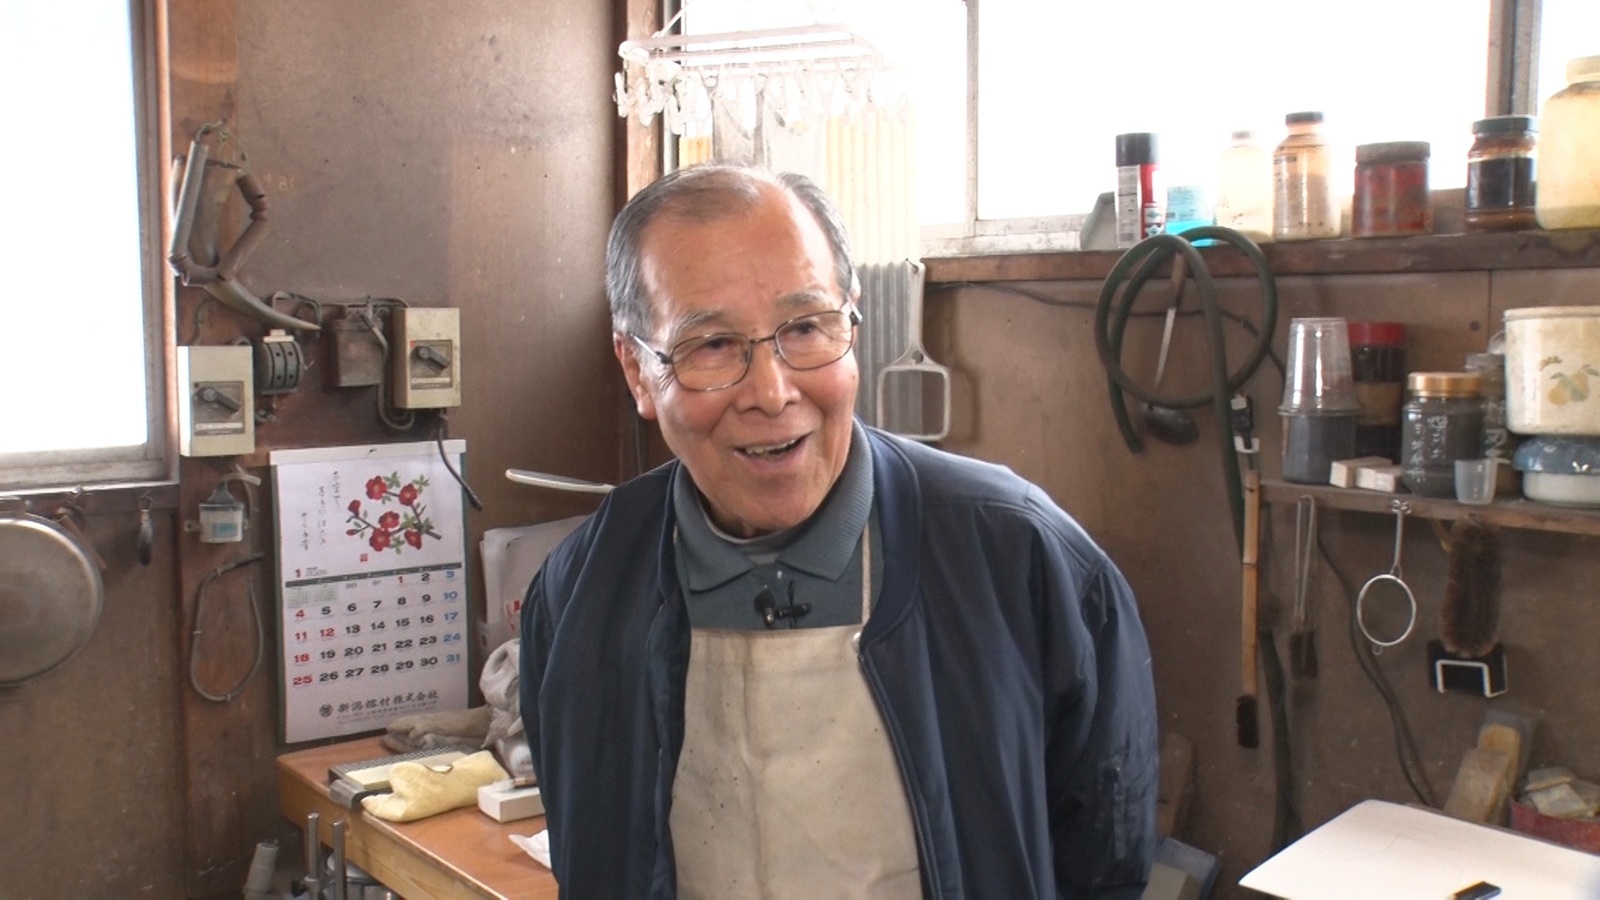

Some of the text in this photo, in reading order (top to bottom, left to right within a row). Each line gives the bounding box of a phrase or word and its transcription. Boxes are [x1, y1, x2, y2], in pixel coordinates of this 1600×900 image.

[295, 569, 301, 578] 1
[398, 575, 404, 584] 1
[421, 572, 431, 582] 2
[446, 570, 455, 579] 3
[295, 591, 458, 618] 4 5 6 7 8 9 10
[295, 612, 458, 640] 11 12 13 14 15 16 17
[294, 633, 461, 663] 18 19 20 21 22 23 24
[293, 654, 460, 685] 25 26 27 28 29 30 31
